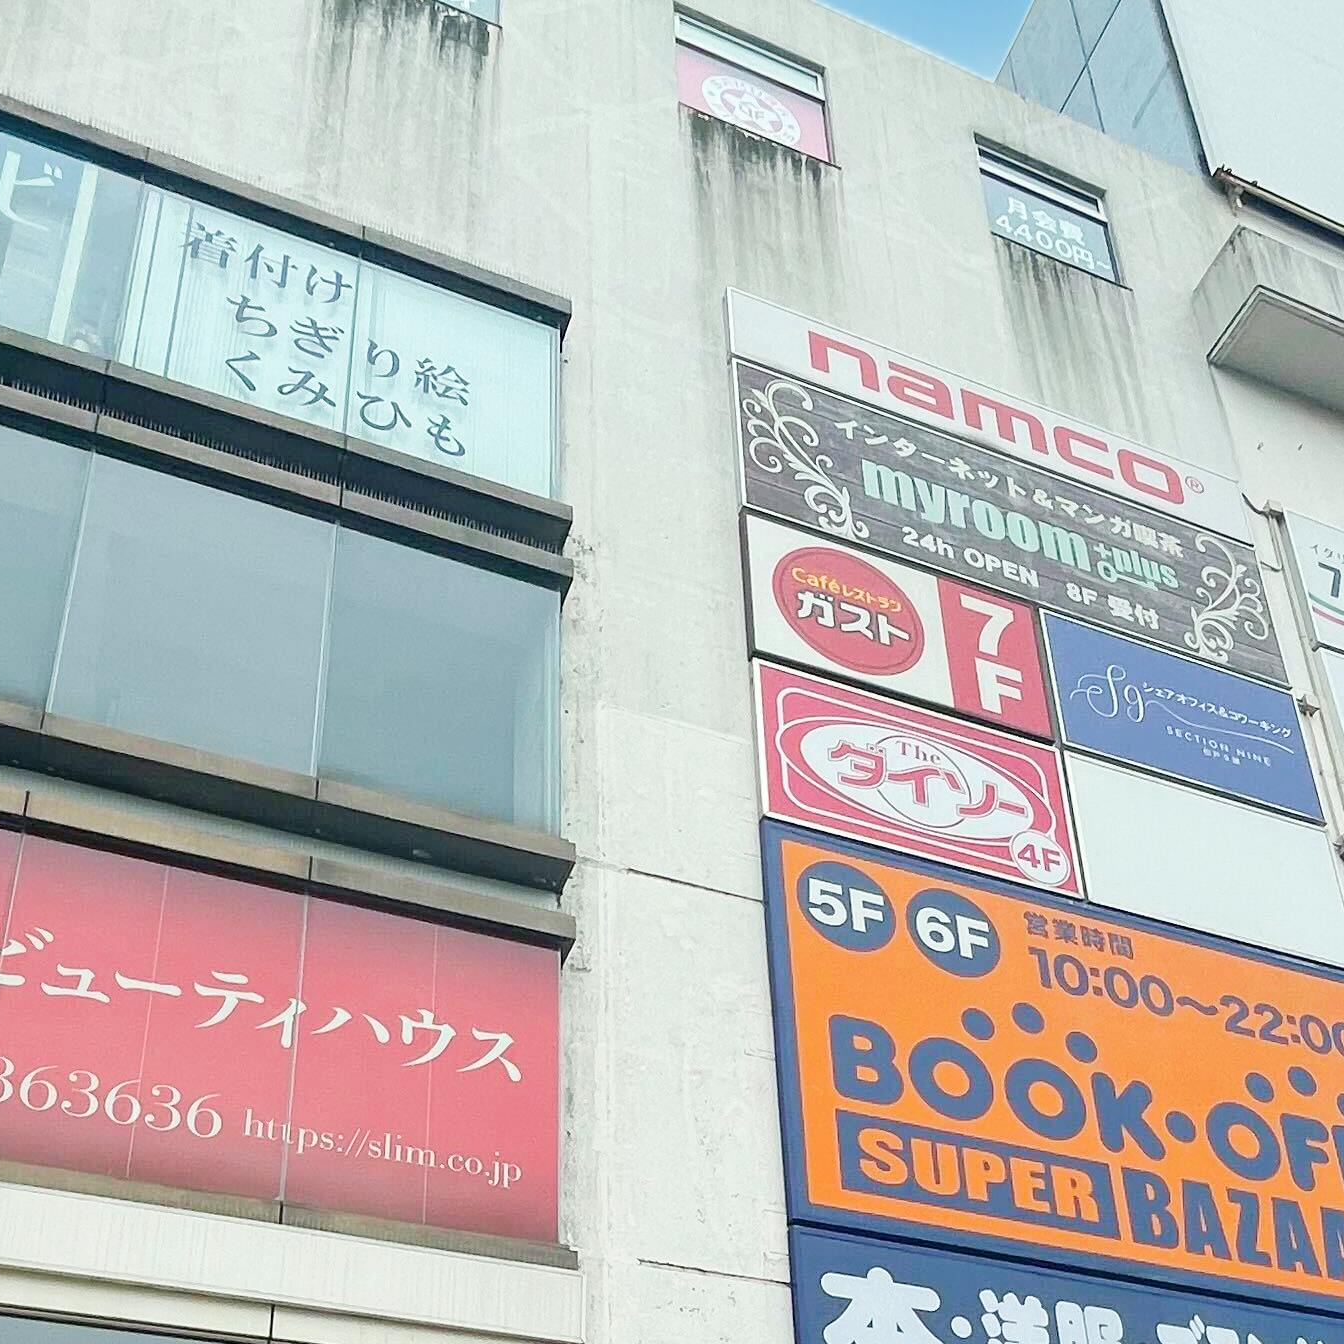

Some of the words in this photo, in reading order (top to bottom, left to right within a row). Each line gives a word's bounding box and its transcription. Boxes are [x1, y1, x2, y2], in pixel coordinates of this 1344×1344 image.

[182, 222, 354, 304] 着付け
[225, 294, 473, 407] ちぎり絵
[224, 350, 466, 457] くみひも
[807, 330, 1185, 505] namco
[860, 458, 1093, 573] myroom
[901, 527, 956, 560] 24h
[963, 545, 1039, 589] OPEN
[1065, 583, 1098, 606] 8F
[796, 590, 911, 646] ガスト
[959, 593, 1023, 716] 7F
[827, 739, 1029, 820] ダイソー
[895, 740, 942, 766] The
[1016, 843, 1061, 873] 4F
[805, 877, 886, 934] 5F
[914, 906, 990, 960] 6F
[1021, 911, 1135, 961] 営業時間
[242, 1107, 523, 1190] https://slim.co.jp
[856, 1129, 1100, 1223] SUPER
